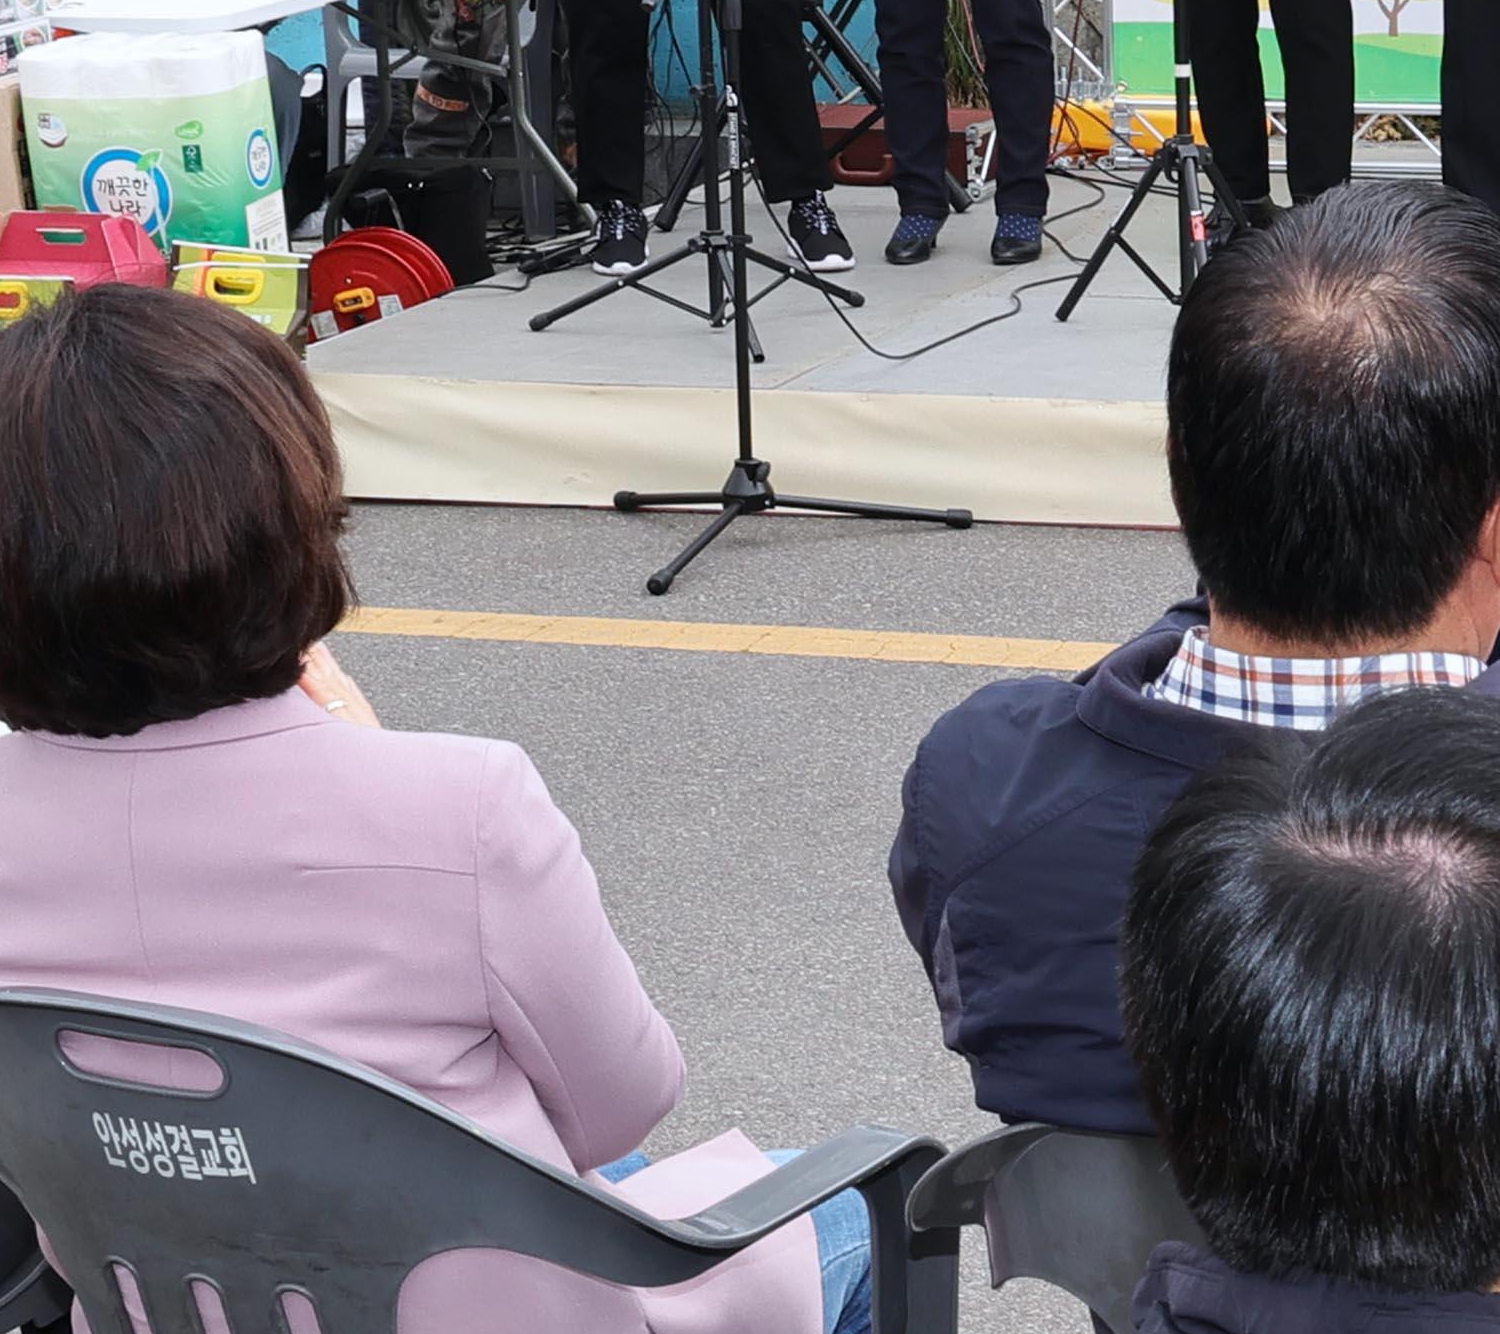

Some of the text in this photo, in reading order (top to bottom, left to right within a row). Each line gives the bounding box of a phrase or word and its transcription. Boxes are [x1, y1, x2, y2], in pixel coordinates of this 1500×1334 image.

[96, 175, 149, 197] 깨끗한
[109, 199, 142, 216] 나라
[92, 1112, 257, 1185] 안성성결교회
